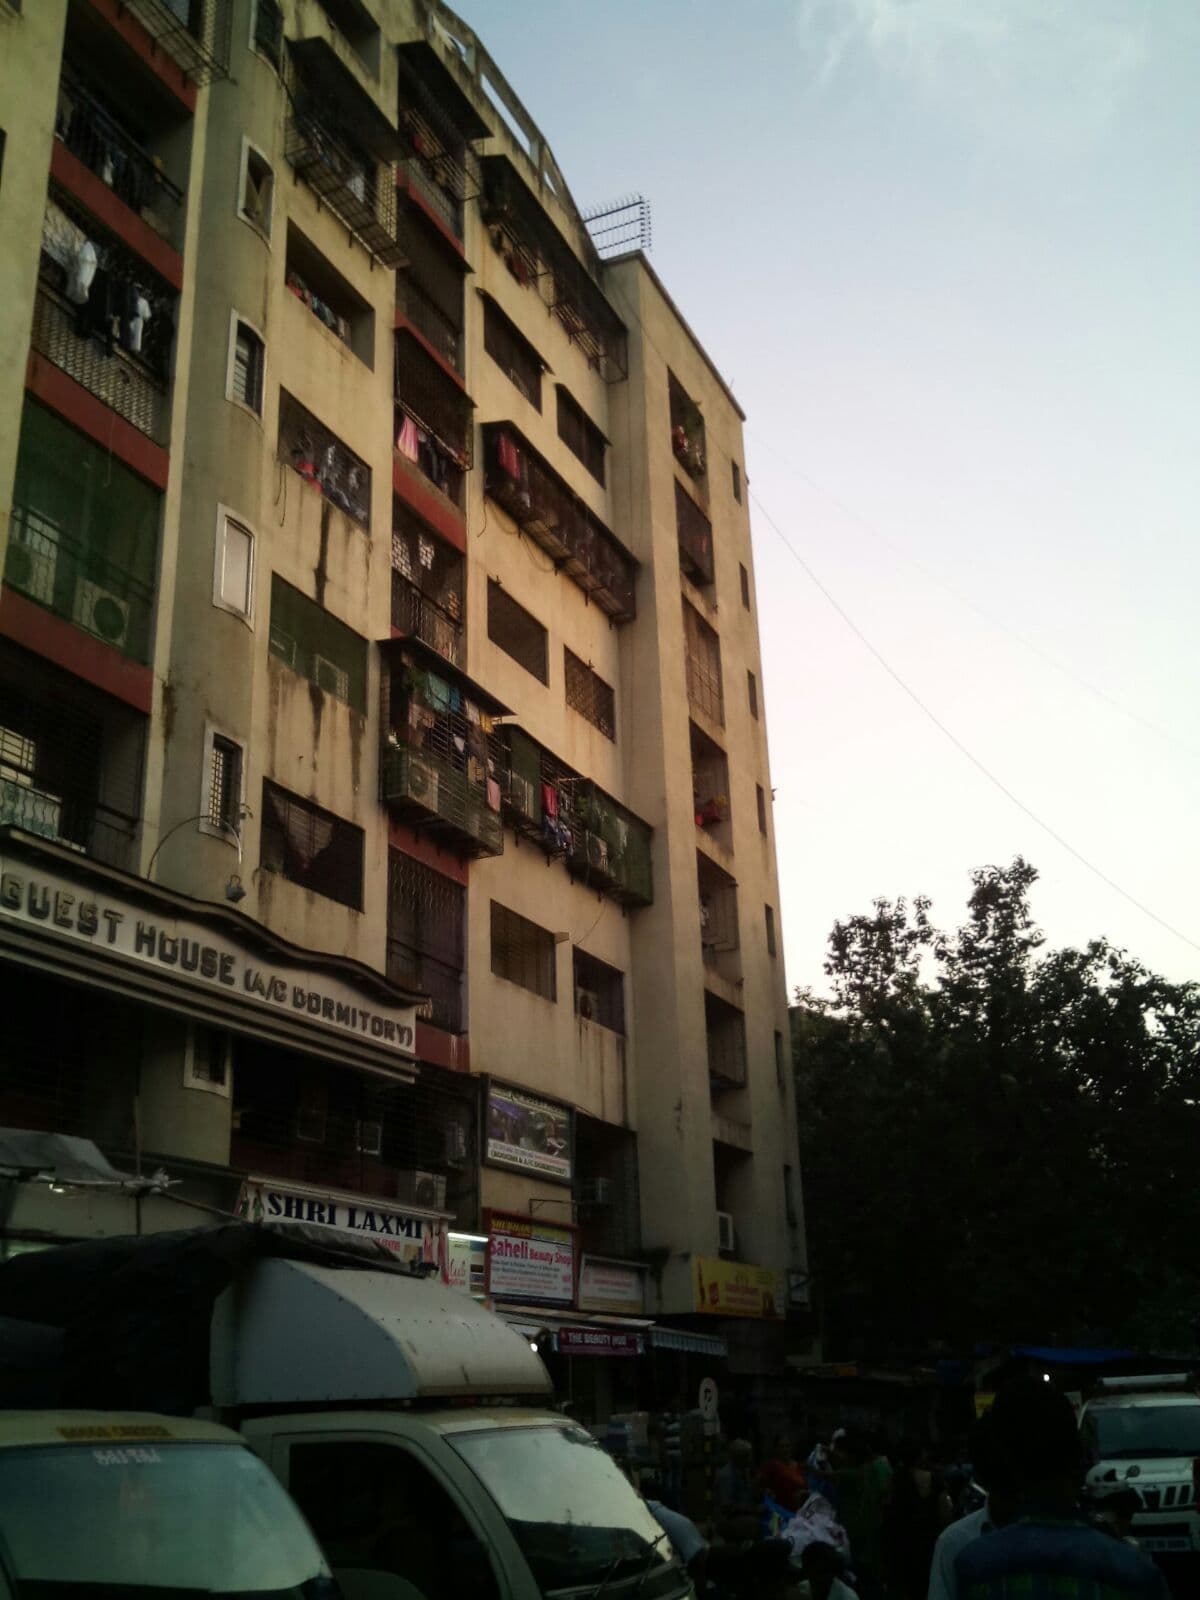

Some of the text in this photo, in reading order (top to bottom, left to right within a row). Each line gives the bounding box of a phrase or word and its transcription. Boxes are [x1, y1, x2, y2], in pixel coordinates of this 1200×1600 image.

[1, 872, 124, 944] GUEST
[135, 919, 237, 985] HOUSE
[292, 986, 413, 1047] DORMITORY)
[268, 1192, 422, 1239] SHRI LAXMI
[489, 1234, 529, 1260] Saheli
